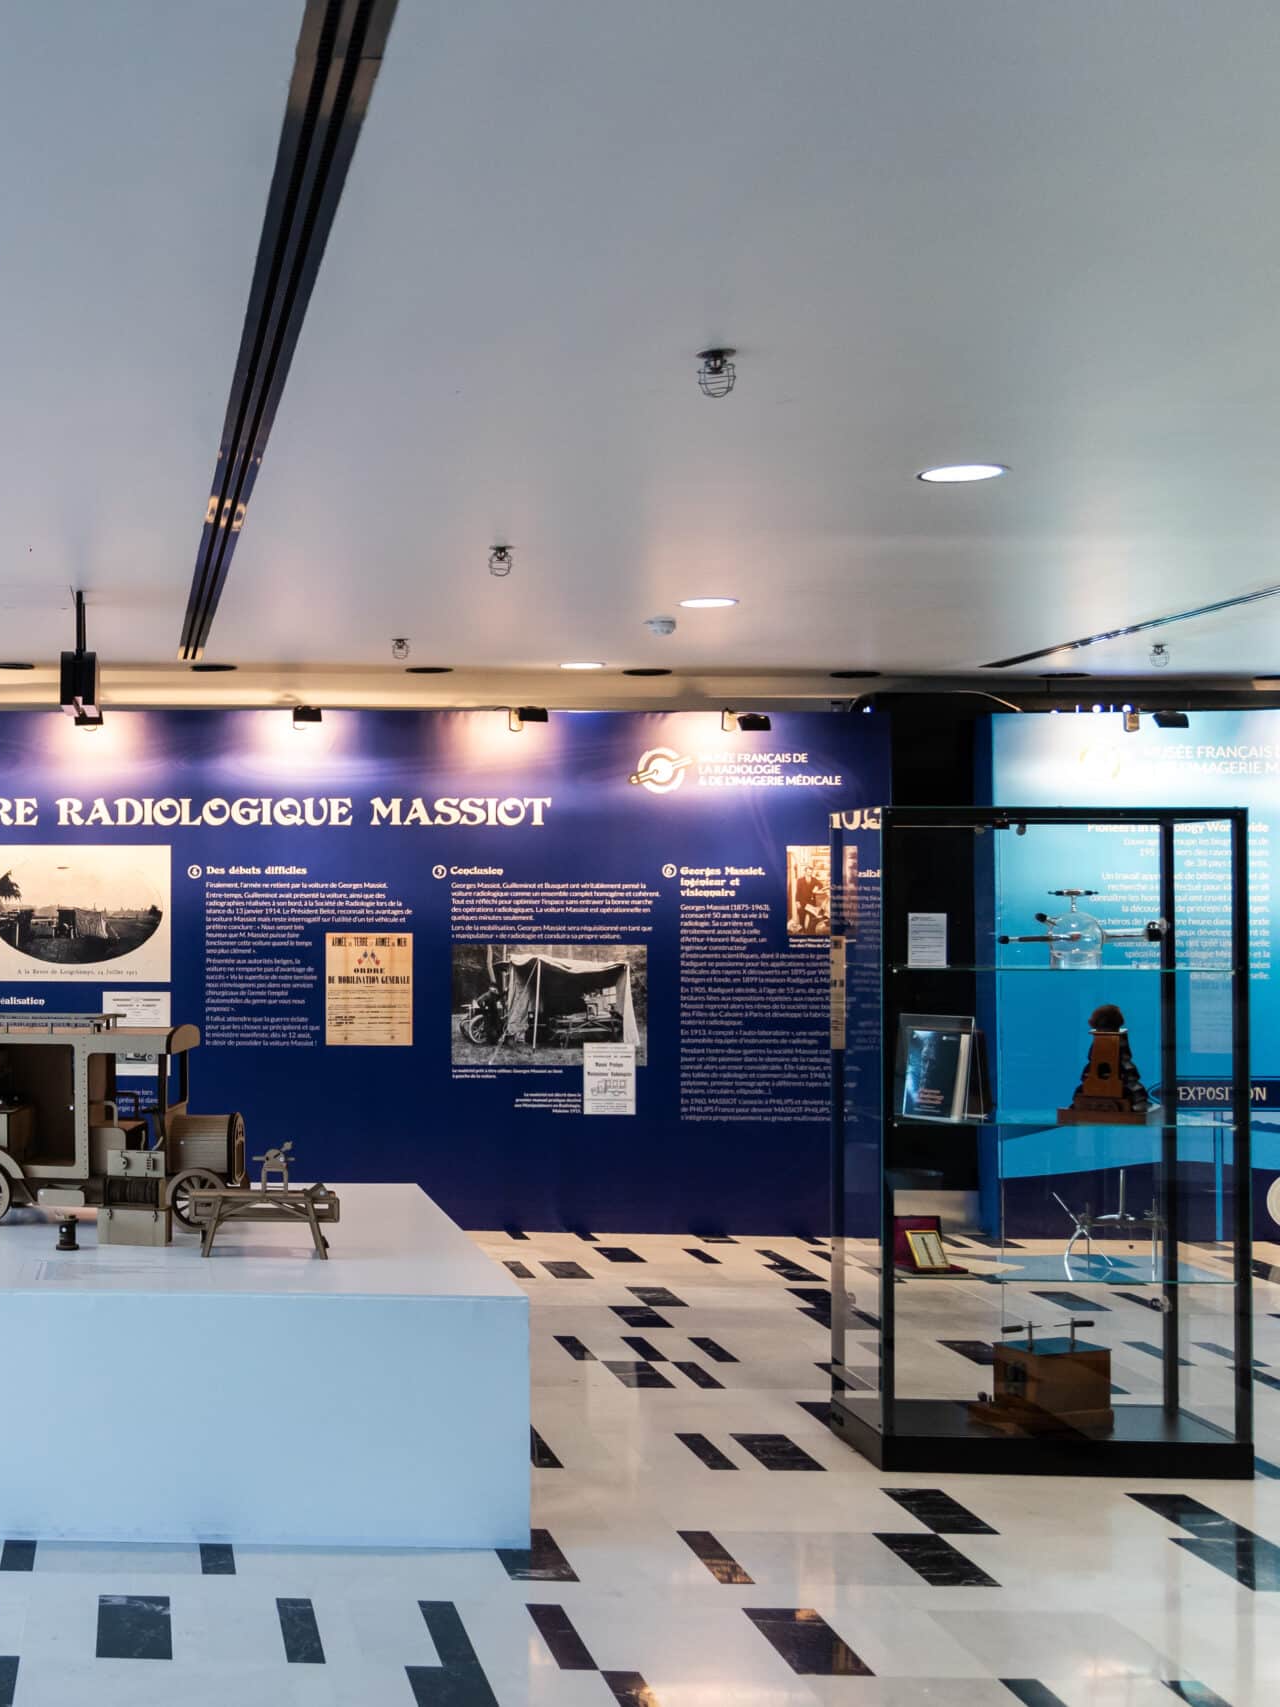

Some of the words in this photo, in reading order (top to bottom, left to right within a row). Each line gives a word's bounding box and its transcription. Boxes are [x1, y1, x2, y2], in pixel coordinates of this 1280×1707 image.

[737, 752, 792, 765] FRANÇAIS
[793, 753, 808, 763] DE
[1196, 745, 1272, 761] FRANÇAIS
[714, 765, 781, 775] RADIOLOGIE
[785, 774, 842, 786] MÉDICALE
[55, 797, 353, 828] RADIOLOGIQUE
[369, 796, 553, 827] MASSIOT
[206, 866, 225, 875] Des
[228, 866, 261, 875] débuts
[264, 865, 307, 875] difficiles
[450, 866, 504, 876] Conclusion
[680, 866, 721, 877] Georges
[338, 975, 380, 985] MOBILISATION
[1178, 1086, 1267, 1101] EXPOSIN
